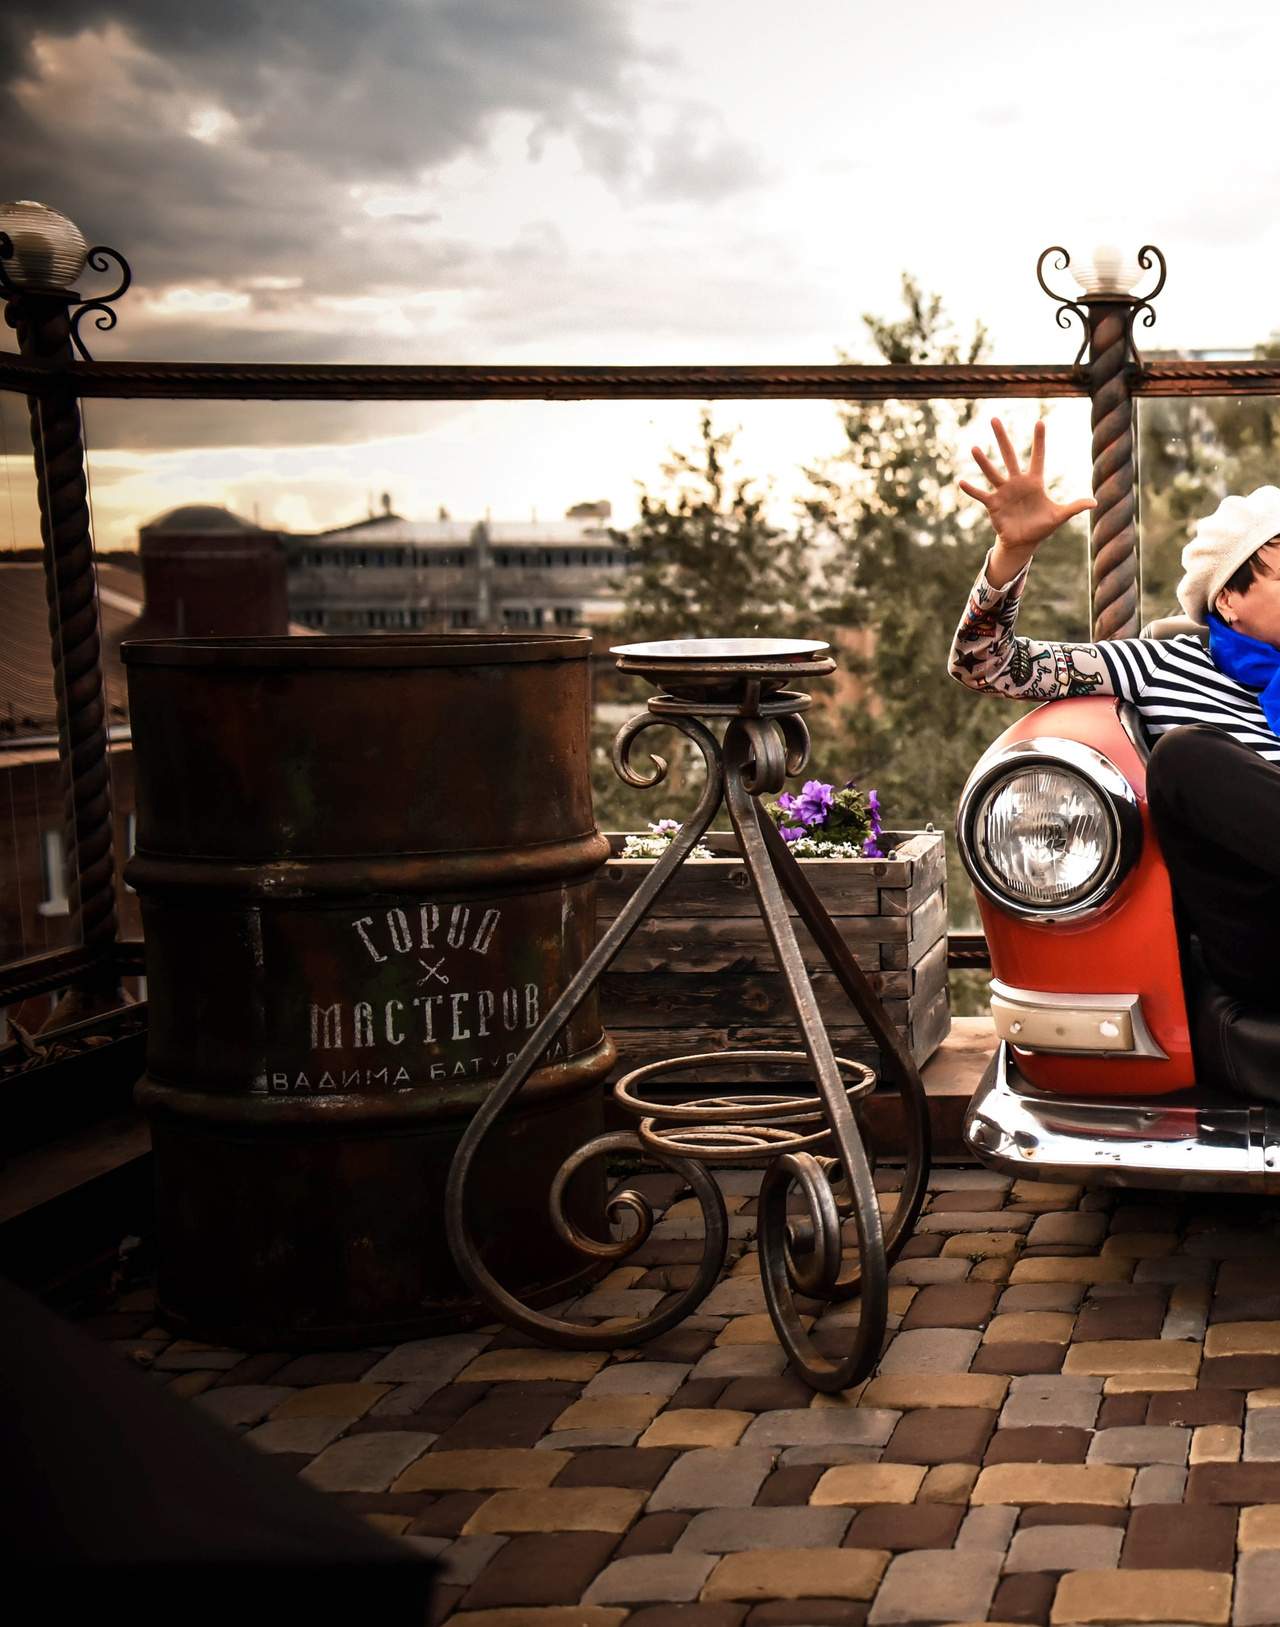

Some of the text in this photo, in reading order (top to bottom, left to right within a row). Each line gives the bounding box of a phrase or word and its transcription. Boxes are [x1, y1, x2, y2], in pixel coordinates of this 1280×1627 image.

[352, 902, 501, 963] ГОРОД
[309, 982, 540, 1050] МАСТЕРОВ
[272, 1042, 565, 1092] ВАДИМА БАТУРА
